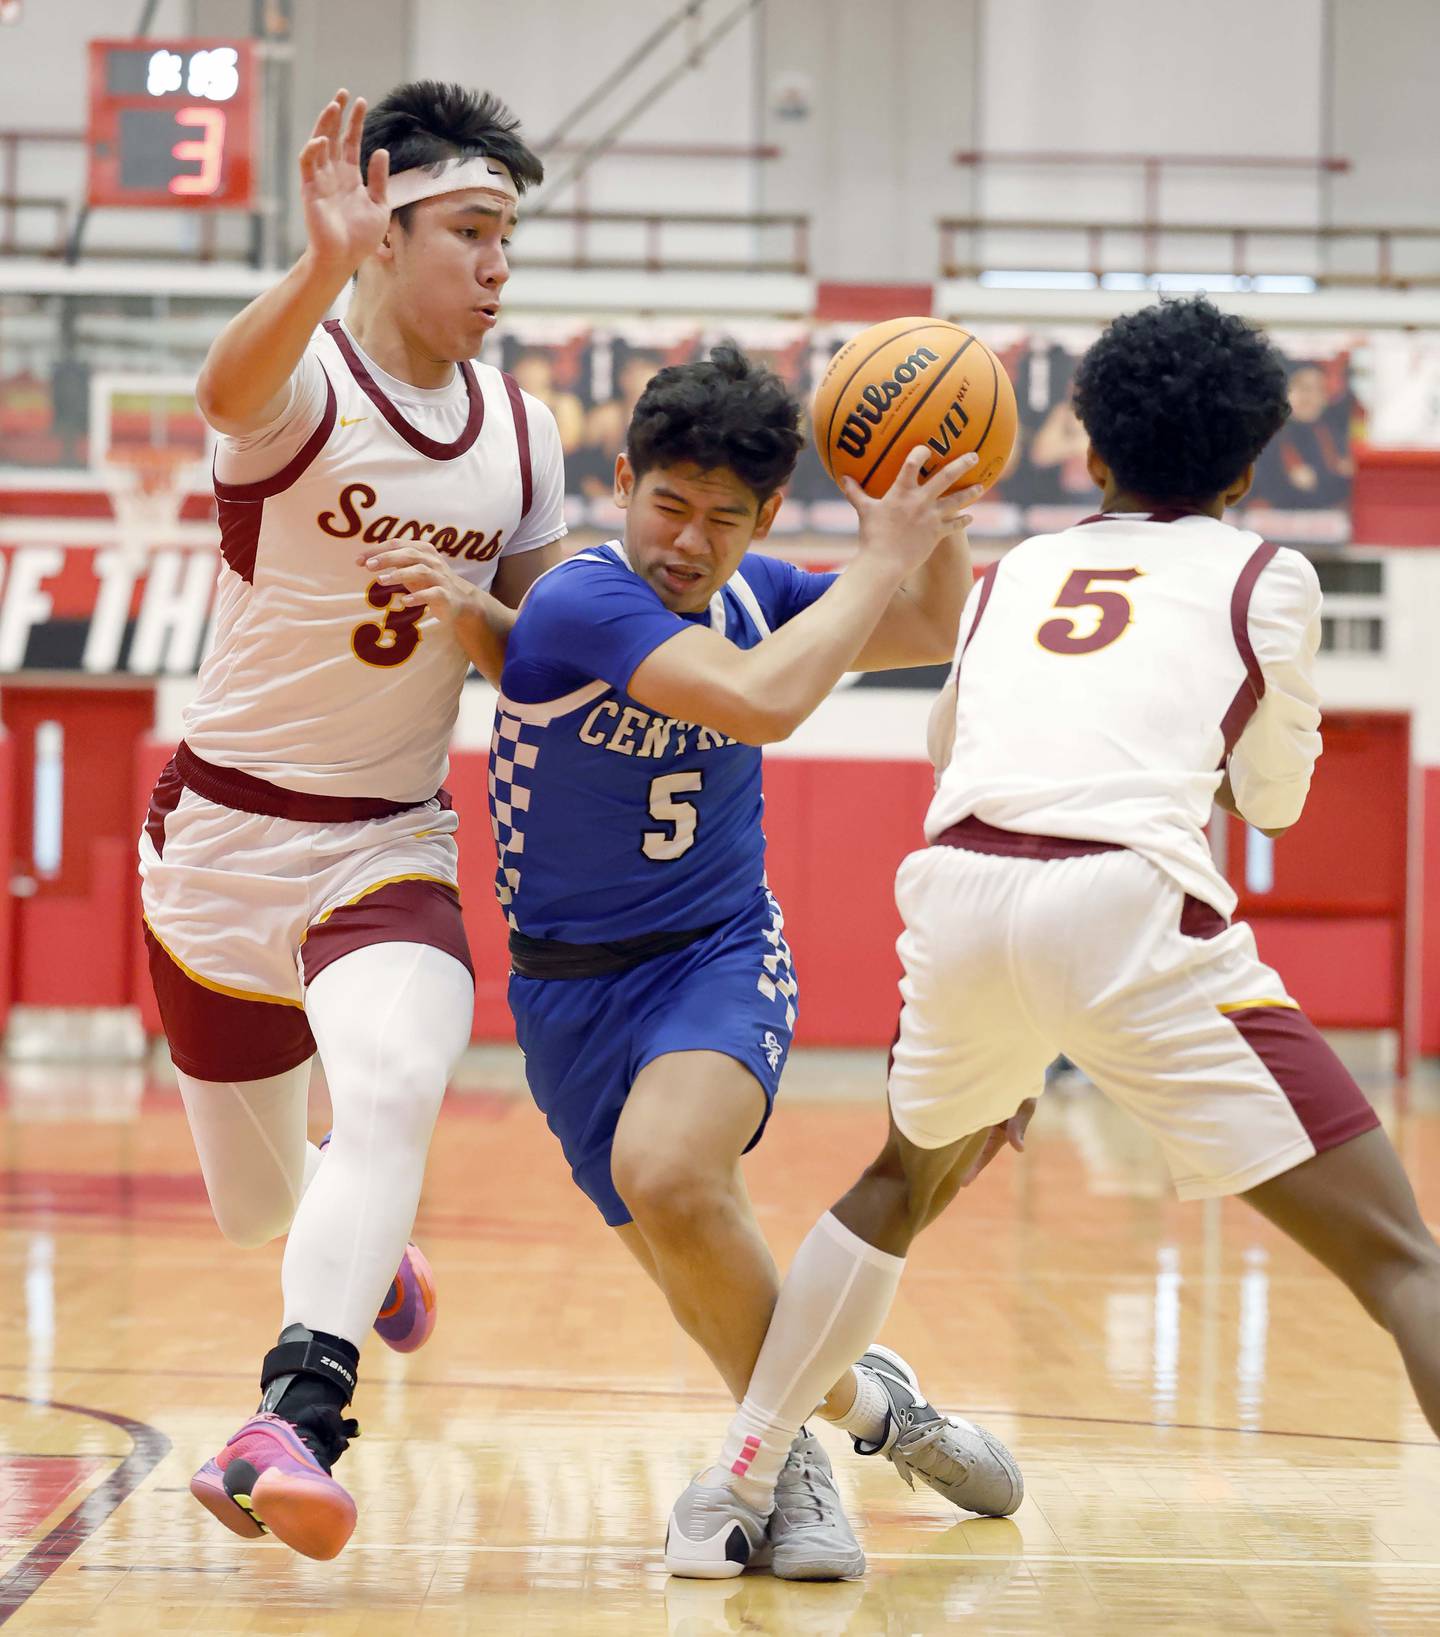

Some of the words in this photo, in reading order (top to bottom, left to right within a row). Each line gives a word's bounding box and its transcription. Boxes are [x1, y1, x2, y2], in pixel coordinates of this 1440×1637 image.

[168, 107, 226, 195] 3
[836, 346, 940, 459] Wilson
[957, 376, 971, 402] NXT
[317, 483, 503, 562] Saxons
[0, 546, 65, 673] F
[82, 547, 220, 674] TH
[351, 578, 430, 669] 3
[1033, 565, 1147, 656] 5
[578, 700, 737, 759] CENTR
[640, 768, 704, 863] 5
